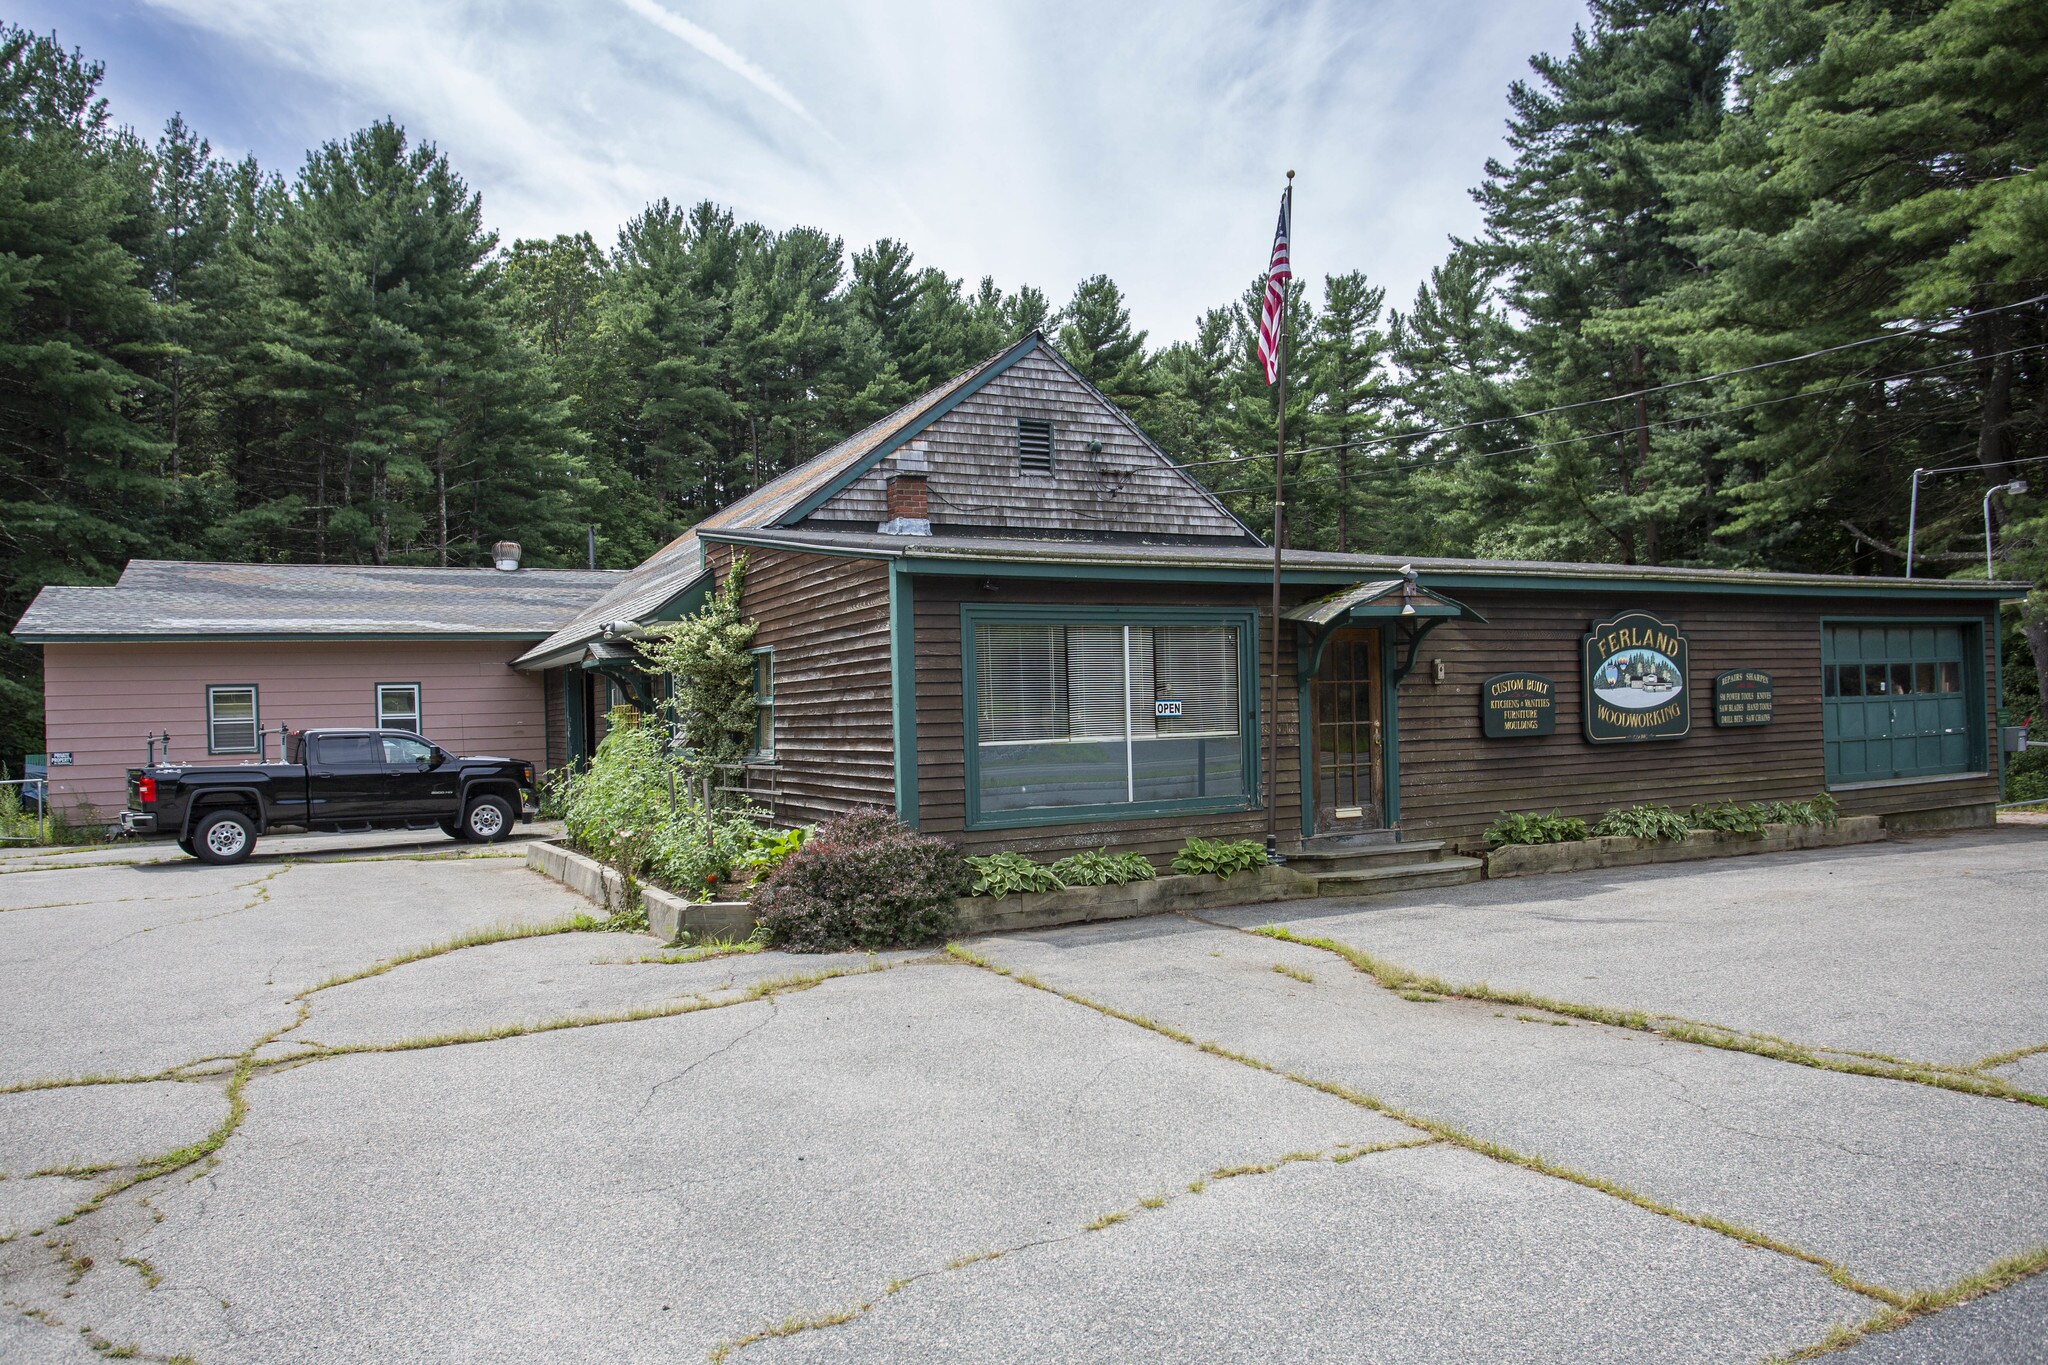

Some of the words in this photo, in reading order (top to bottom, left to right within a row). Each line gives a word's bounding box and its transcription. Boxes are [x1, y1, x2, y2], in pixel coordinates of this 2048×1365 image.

[1597, 627, 1679, 659] FERLAND
[1721, 673, 1743, 686] REPAIRS
[1745, 672, 1769, 684] SHARPEN
[1491, 679, 1524, 696] CUSTOM
[1526, 679, 1550, 695] BUILT
[1726, 692, 1741, 701] POWER
[1741, 692, 1754, 700] TOOLS
[1756, 691, 1772, 700] KNIVES
[1157, 703, 1181, 714] OPEN
[1490, 699, 1520, 709] KITCHENS
[1524, 698, 1551, 708] VANITIES
[1719, 704, 1729, 713] SAW
[1728, 703, 1744, 712] BLADES
[1746, 703, 1759, 711] HAND
[1759, 702, 1773, 711] TOOLS
[1503, 710, 1538, 720] FURNITURE
[1597, 702, 1681, 728] WOODWORKING
[1721, 715, 1733, 724] DRILL
[1733, 715, 1744, 723] BITS
[1745, 714, 1755, 723] SAW
[1755, 713, 1771, 722] CHAINS
[1503, 720, 1539, 730] MOULDINGS
